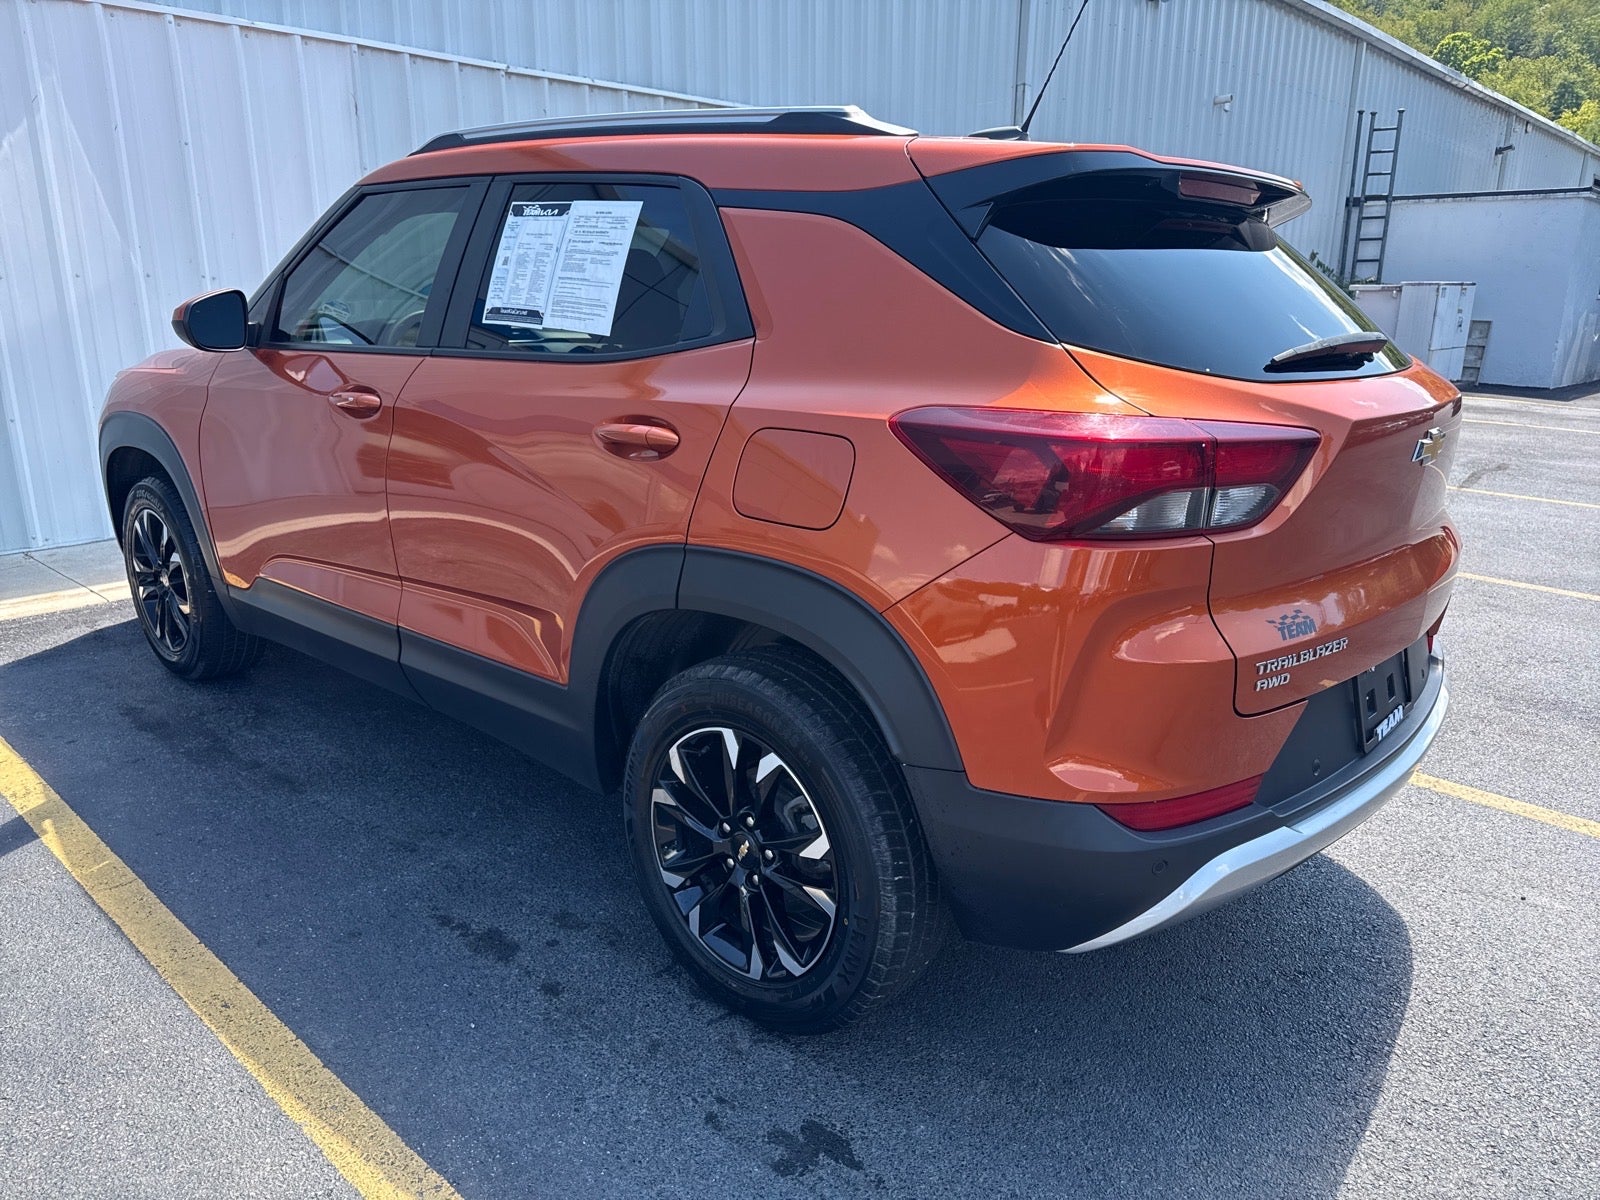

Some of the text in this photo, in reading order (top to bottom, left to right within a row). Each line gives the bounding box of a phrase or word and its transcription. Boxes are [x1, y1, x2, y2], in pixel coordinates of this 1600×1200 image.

[1277, 620, 1318, 641] TEAM
[1255, 637, 1349, 676] TRAILBLAZER
[1255, 672, 1290, 692] AWD
[1376, 705, 1404, 742] TEAM
